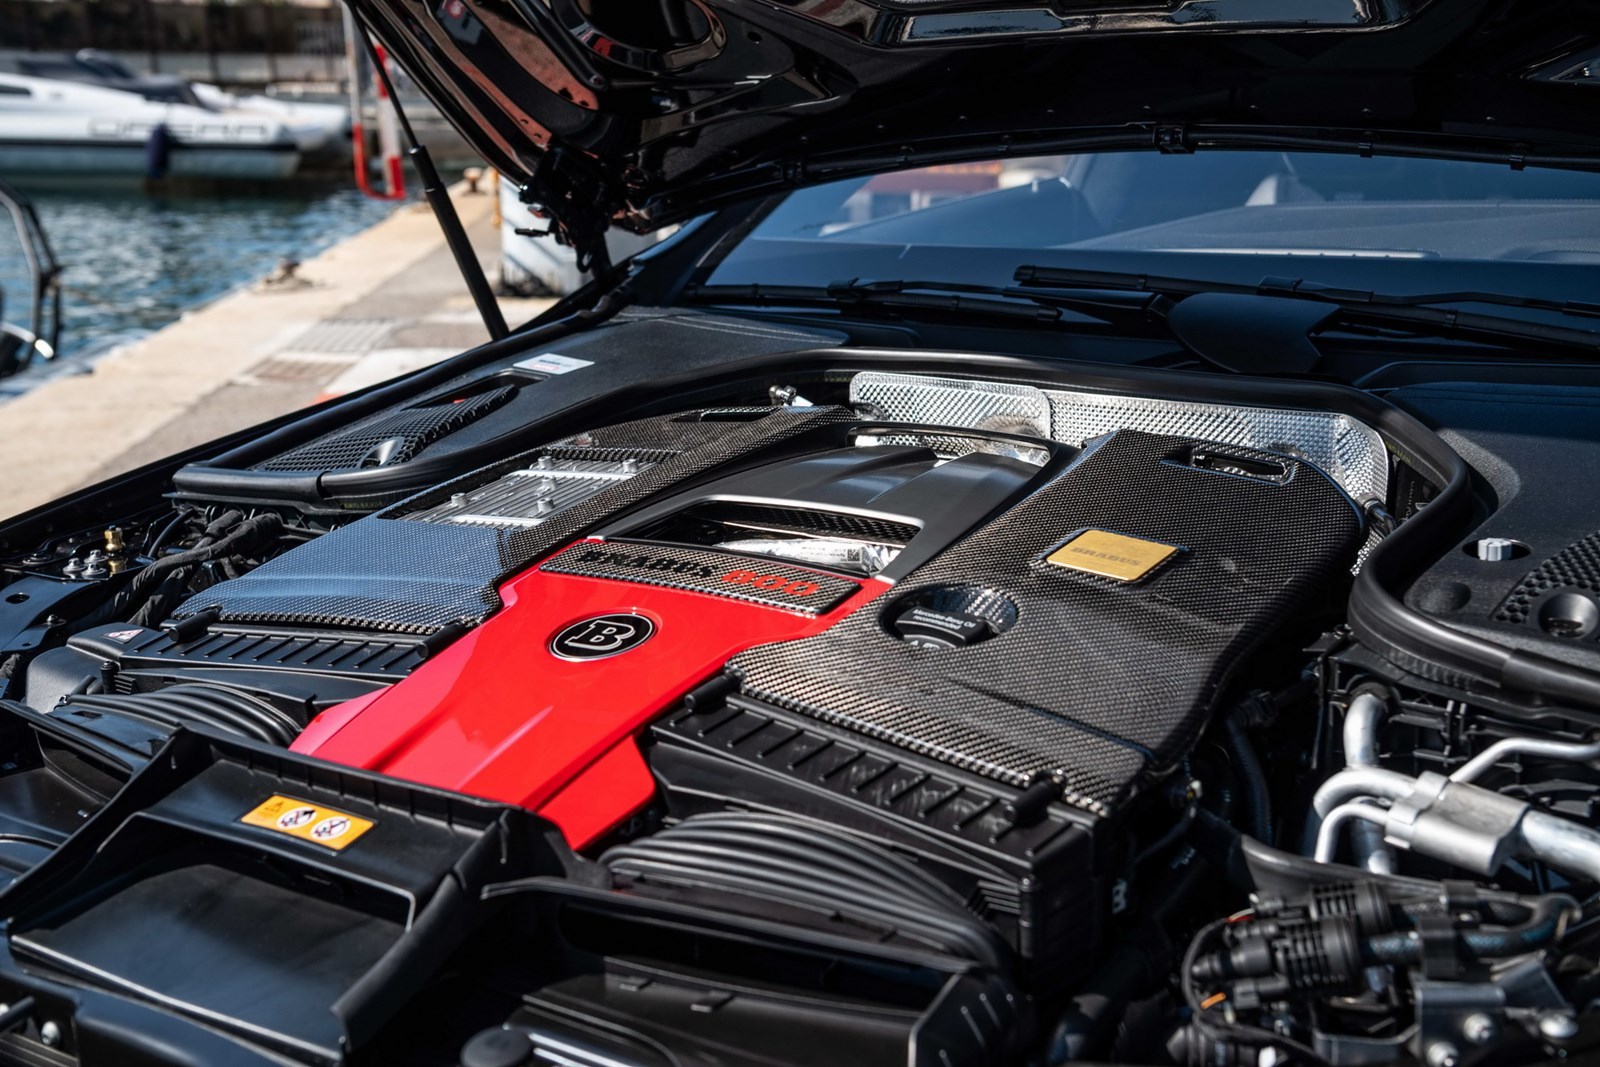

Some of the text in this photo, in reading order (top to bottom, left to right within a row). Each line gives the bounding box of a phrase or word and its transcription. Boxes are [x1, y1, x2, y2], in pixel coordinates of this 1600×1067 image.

[1070, 547, 1141, 566] BRABUS
[577, 550, 820, 596] BRABUS 800
[912, 609, 964, 625] Mercedes-Benz
[564, 620, 636, 651] B
